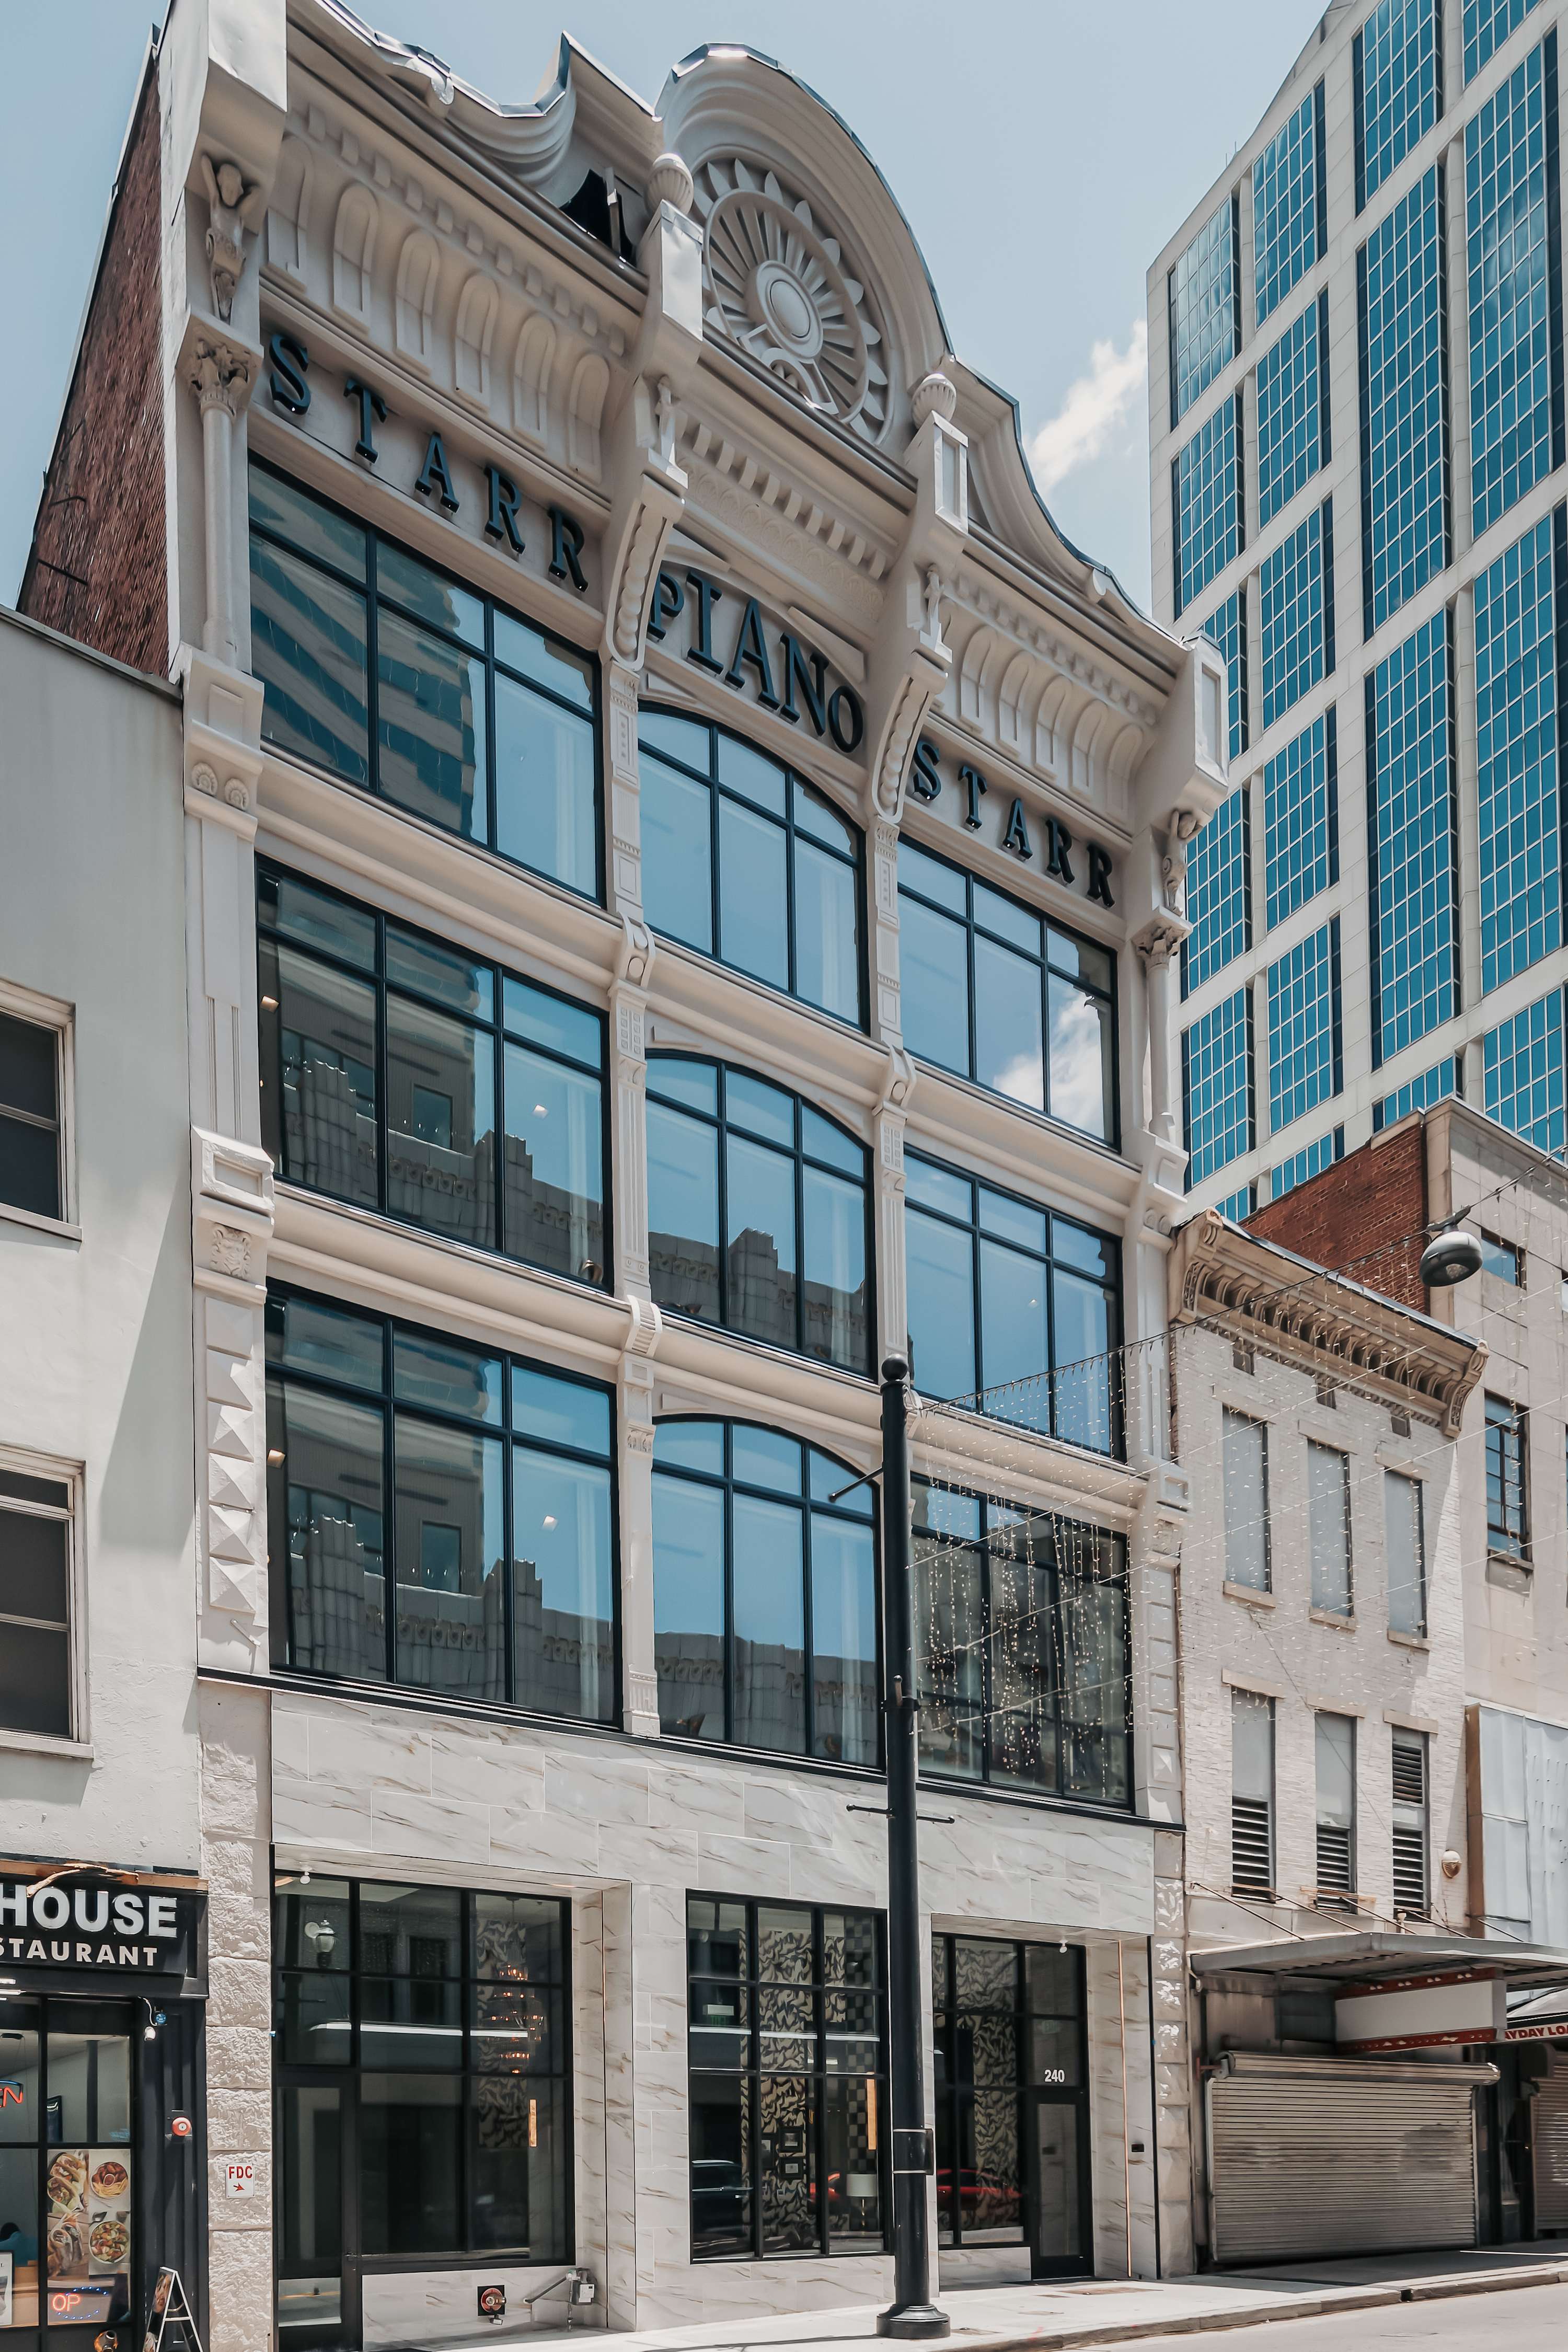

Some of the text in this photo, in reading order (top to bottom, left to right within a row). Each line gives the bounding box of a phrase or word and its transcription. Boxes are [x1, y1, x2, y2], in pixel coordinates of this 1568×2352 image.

[269, 333, 589, 592] STARR
[647, 571, 863, 753] PIANO
[913, 741, 1115, 908] STARR
[0, 1883, 177, 1938] HOUSE
[1547, 2025, 1568, 2035] LO
[1044, 2069, 1065, 2083] 240
[0, 2087, 23, 2107] N
[229, 2165, 252, 2178] FDC
